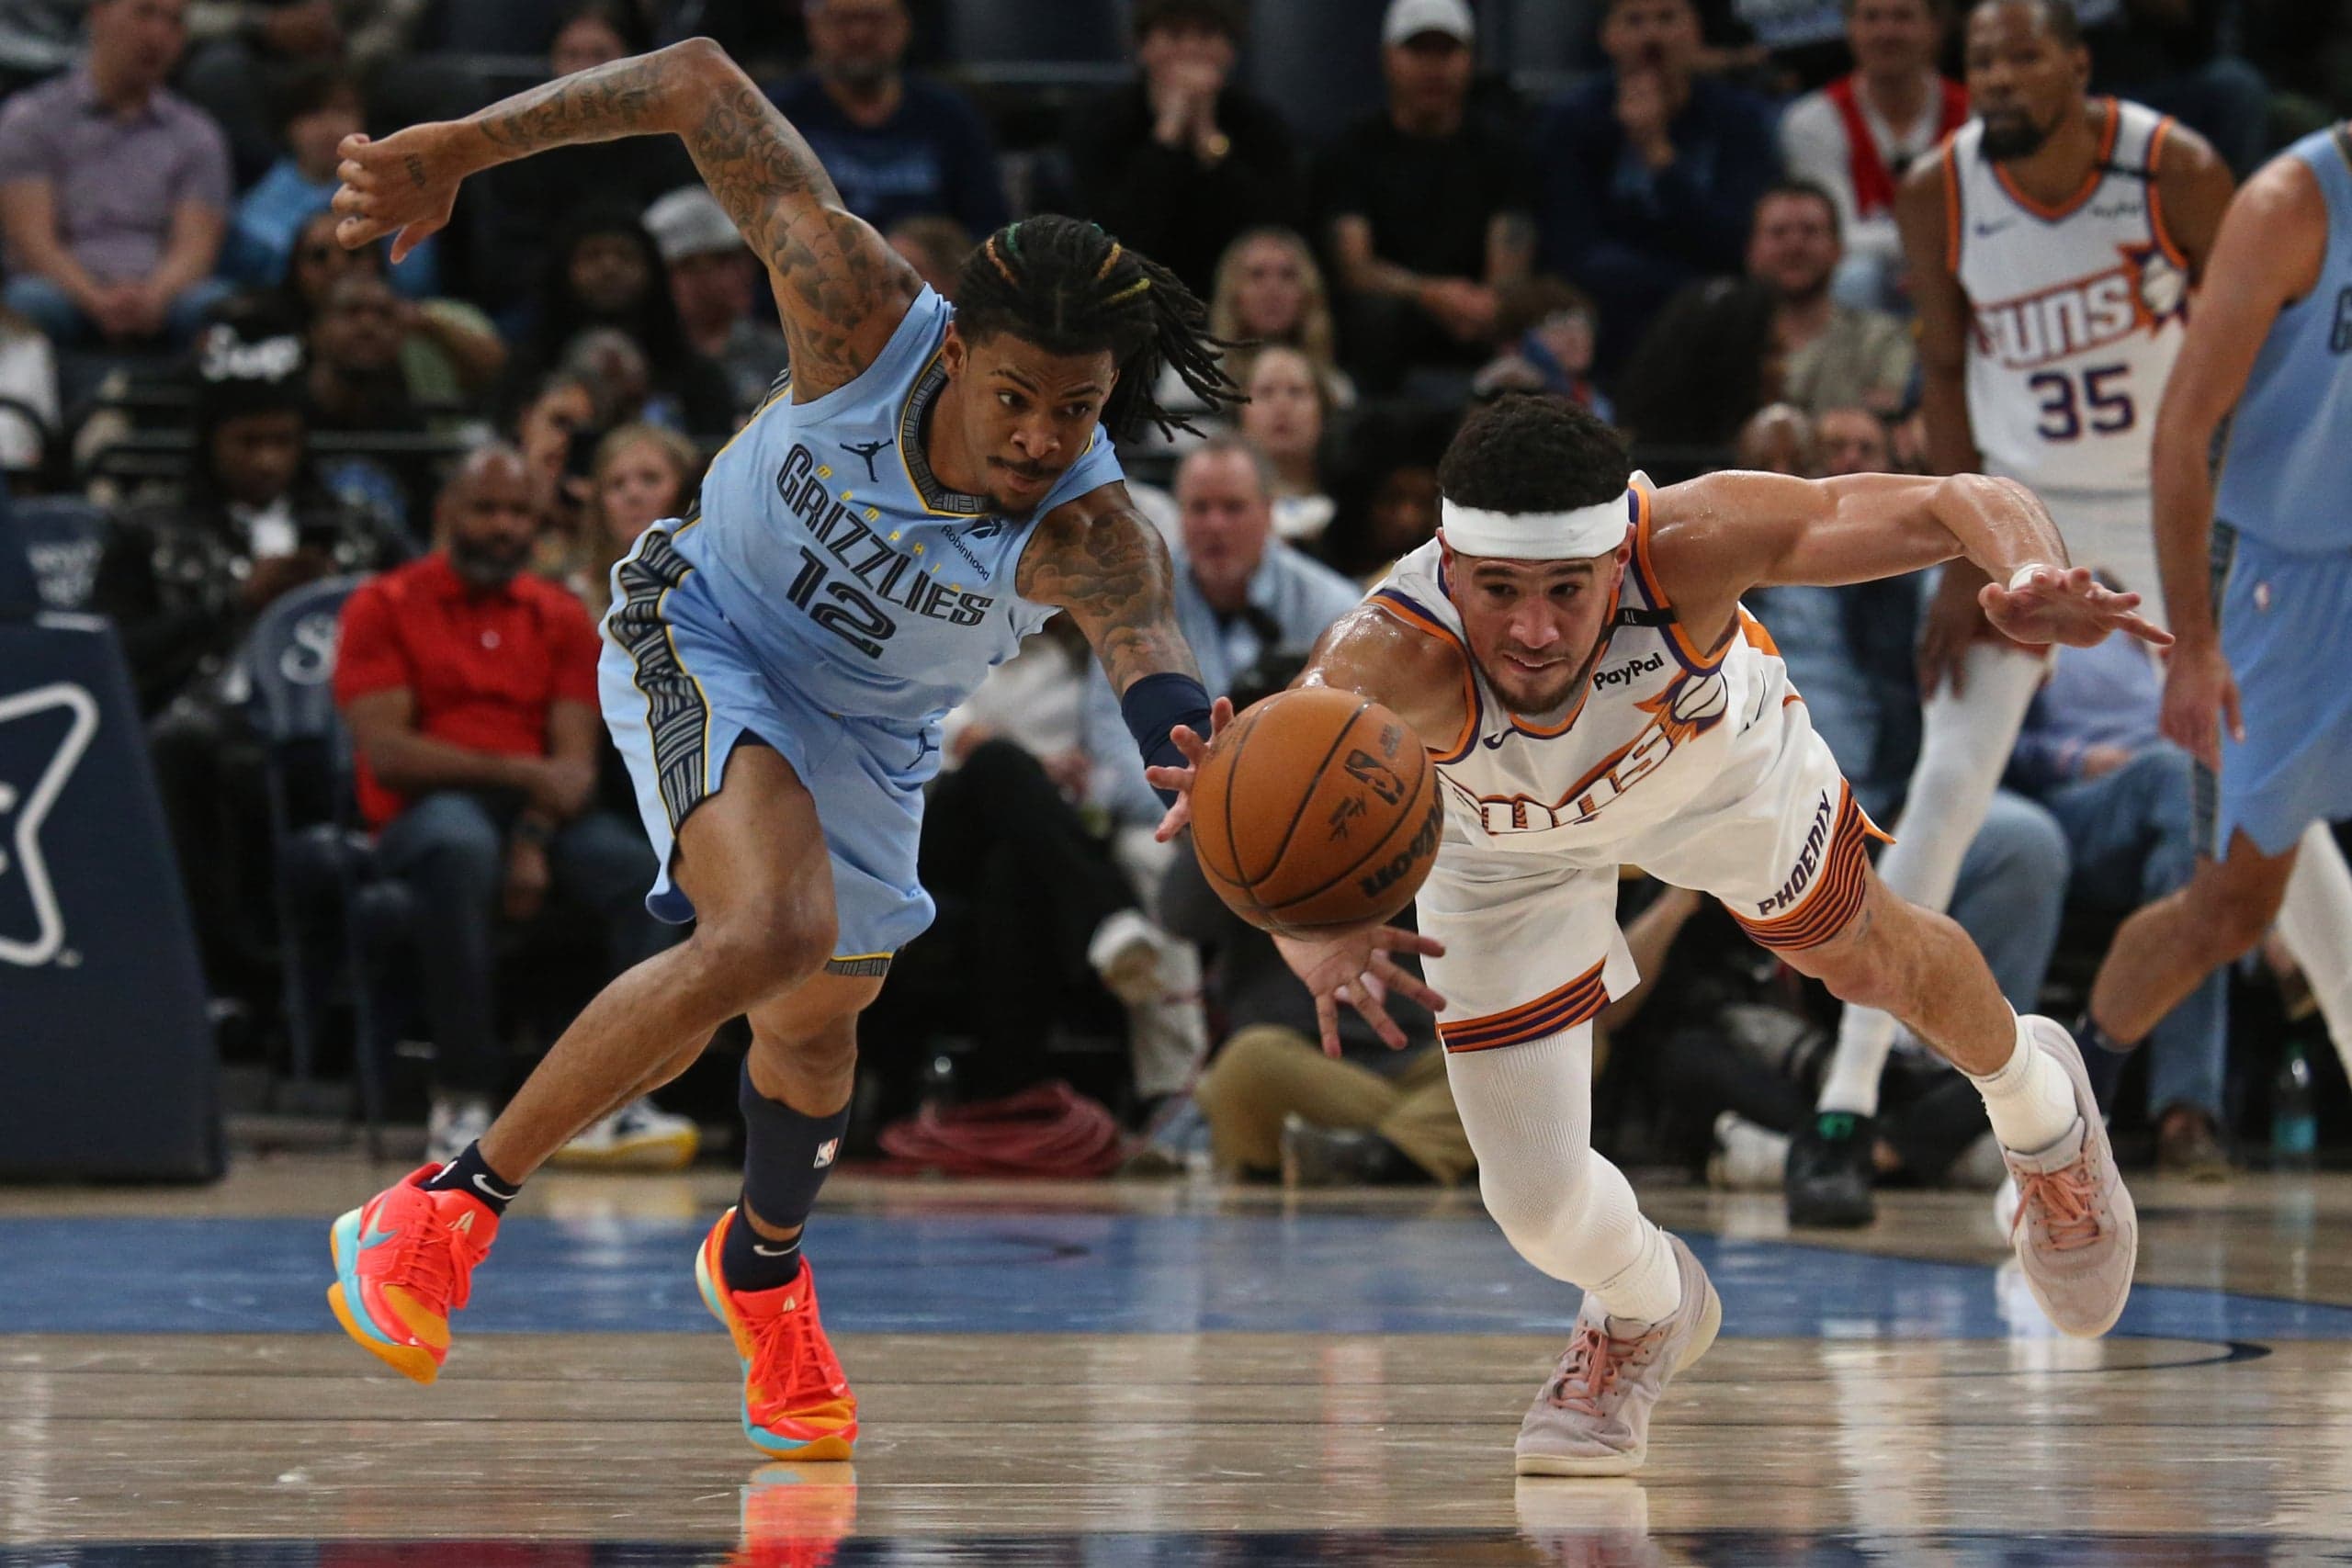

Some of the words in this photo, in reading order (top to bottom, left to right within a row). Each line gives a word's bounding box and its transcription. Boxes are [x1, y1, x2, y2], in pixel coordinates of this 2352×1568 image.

[2030, 366, 2135, 442] 35
[776, 443, 994, 626] GRIZZLIES
[940, 524, 991, 581] Robinhood
[786, 545, 897, 660] 12
[1592, 652, 1665, 692] PayPal
[1756, 788, 1832, 916] PHOENIX
